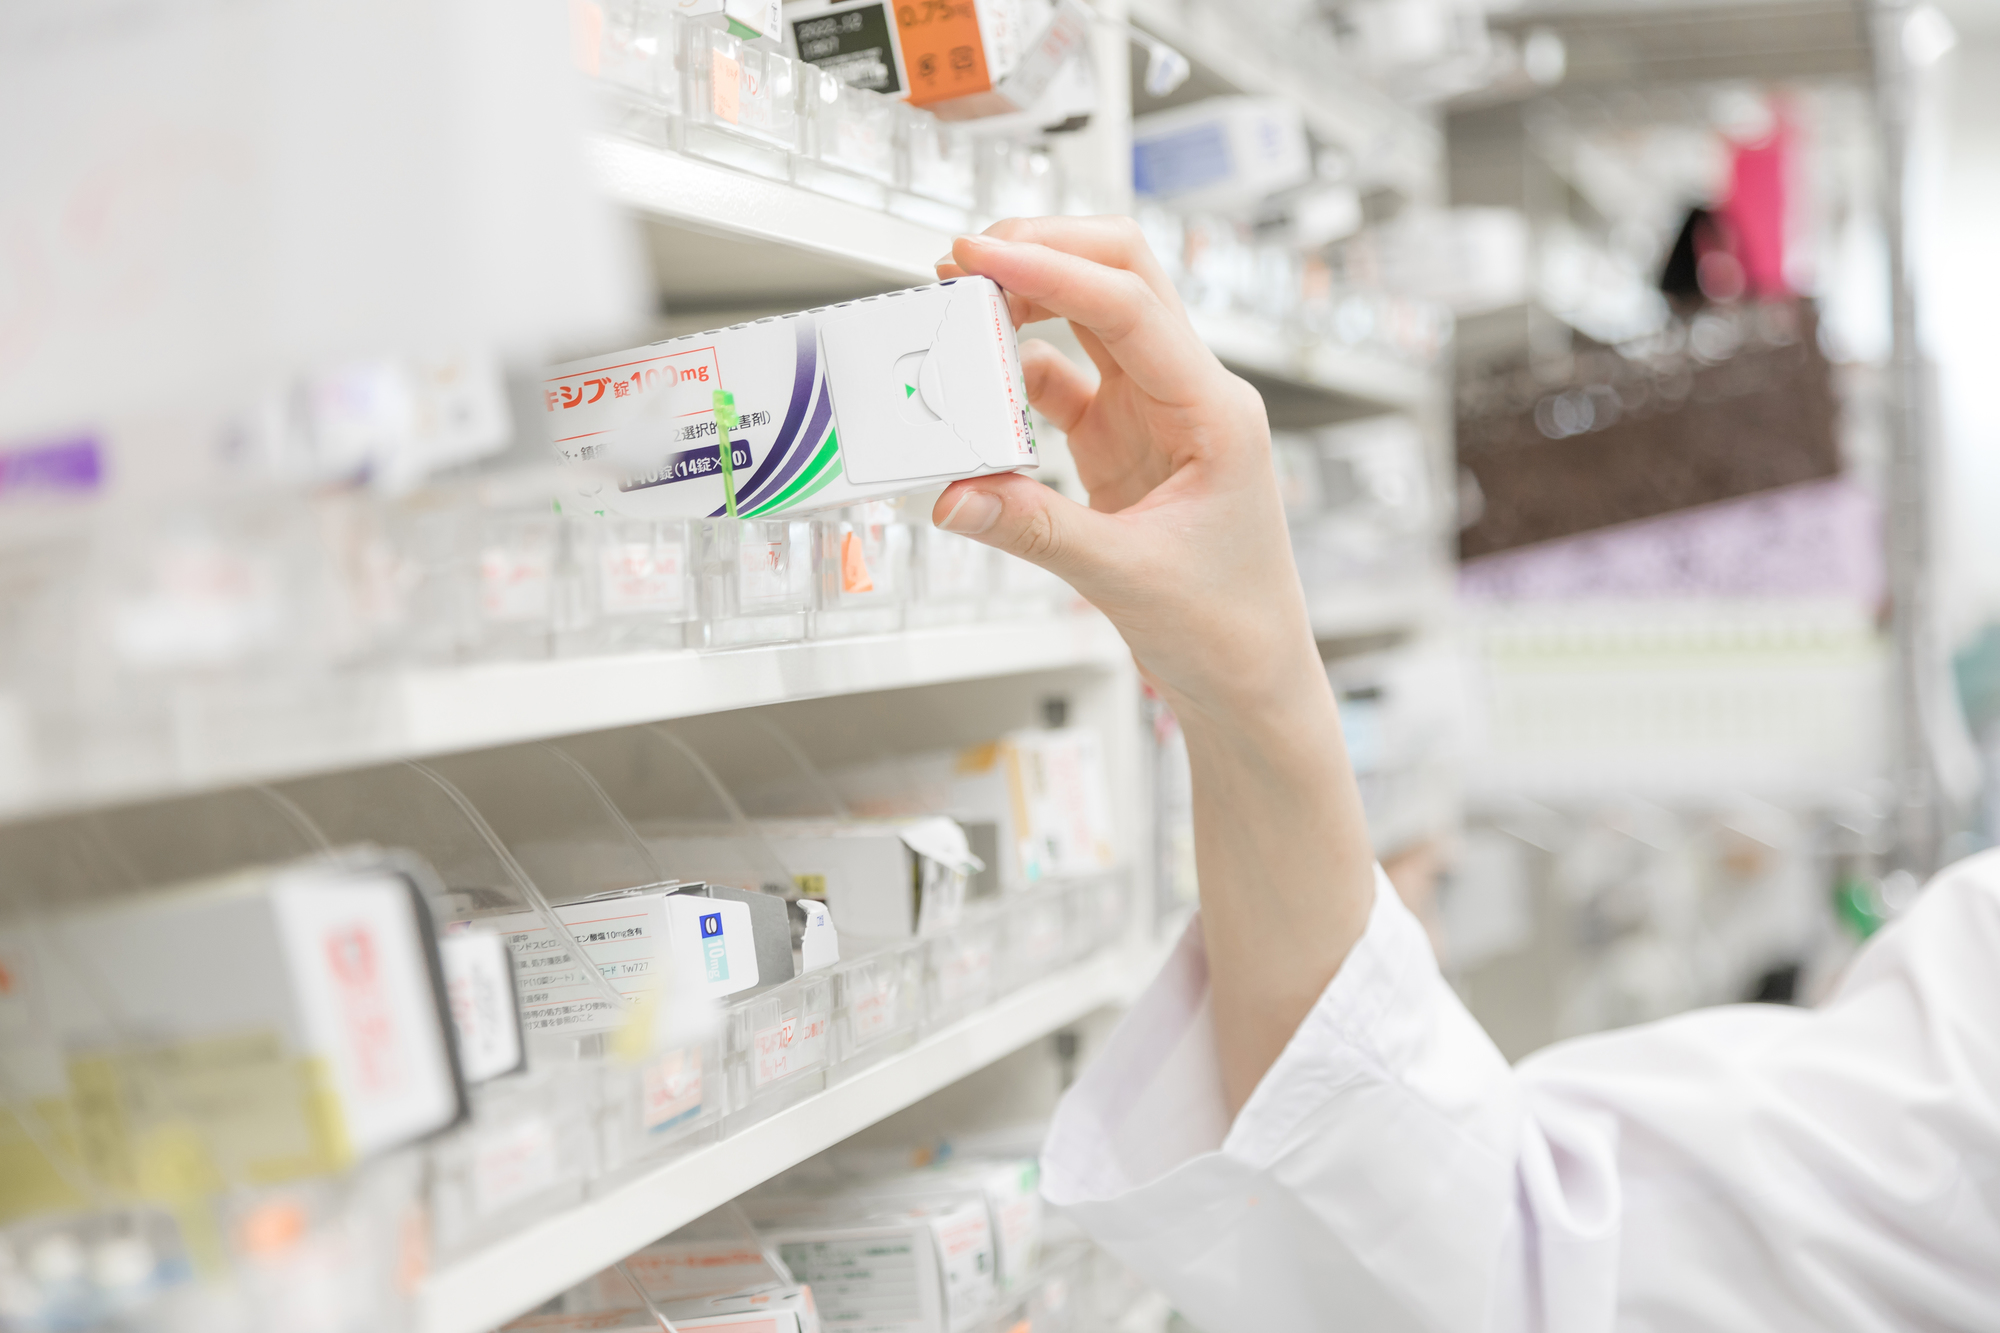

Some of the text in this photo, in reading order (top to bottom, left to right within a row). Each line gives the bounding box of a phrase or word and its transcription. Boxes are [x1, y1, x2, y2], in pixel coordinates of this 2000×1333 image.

[673, 410, 771, 443] 2選択的害剤)
[621, 962, 649, 974] Tw727
[707, 938, 724, 979] 10mg
